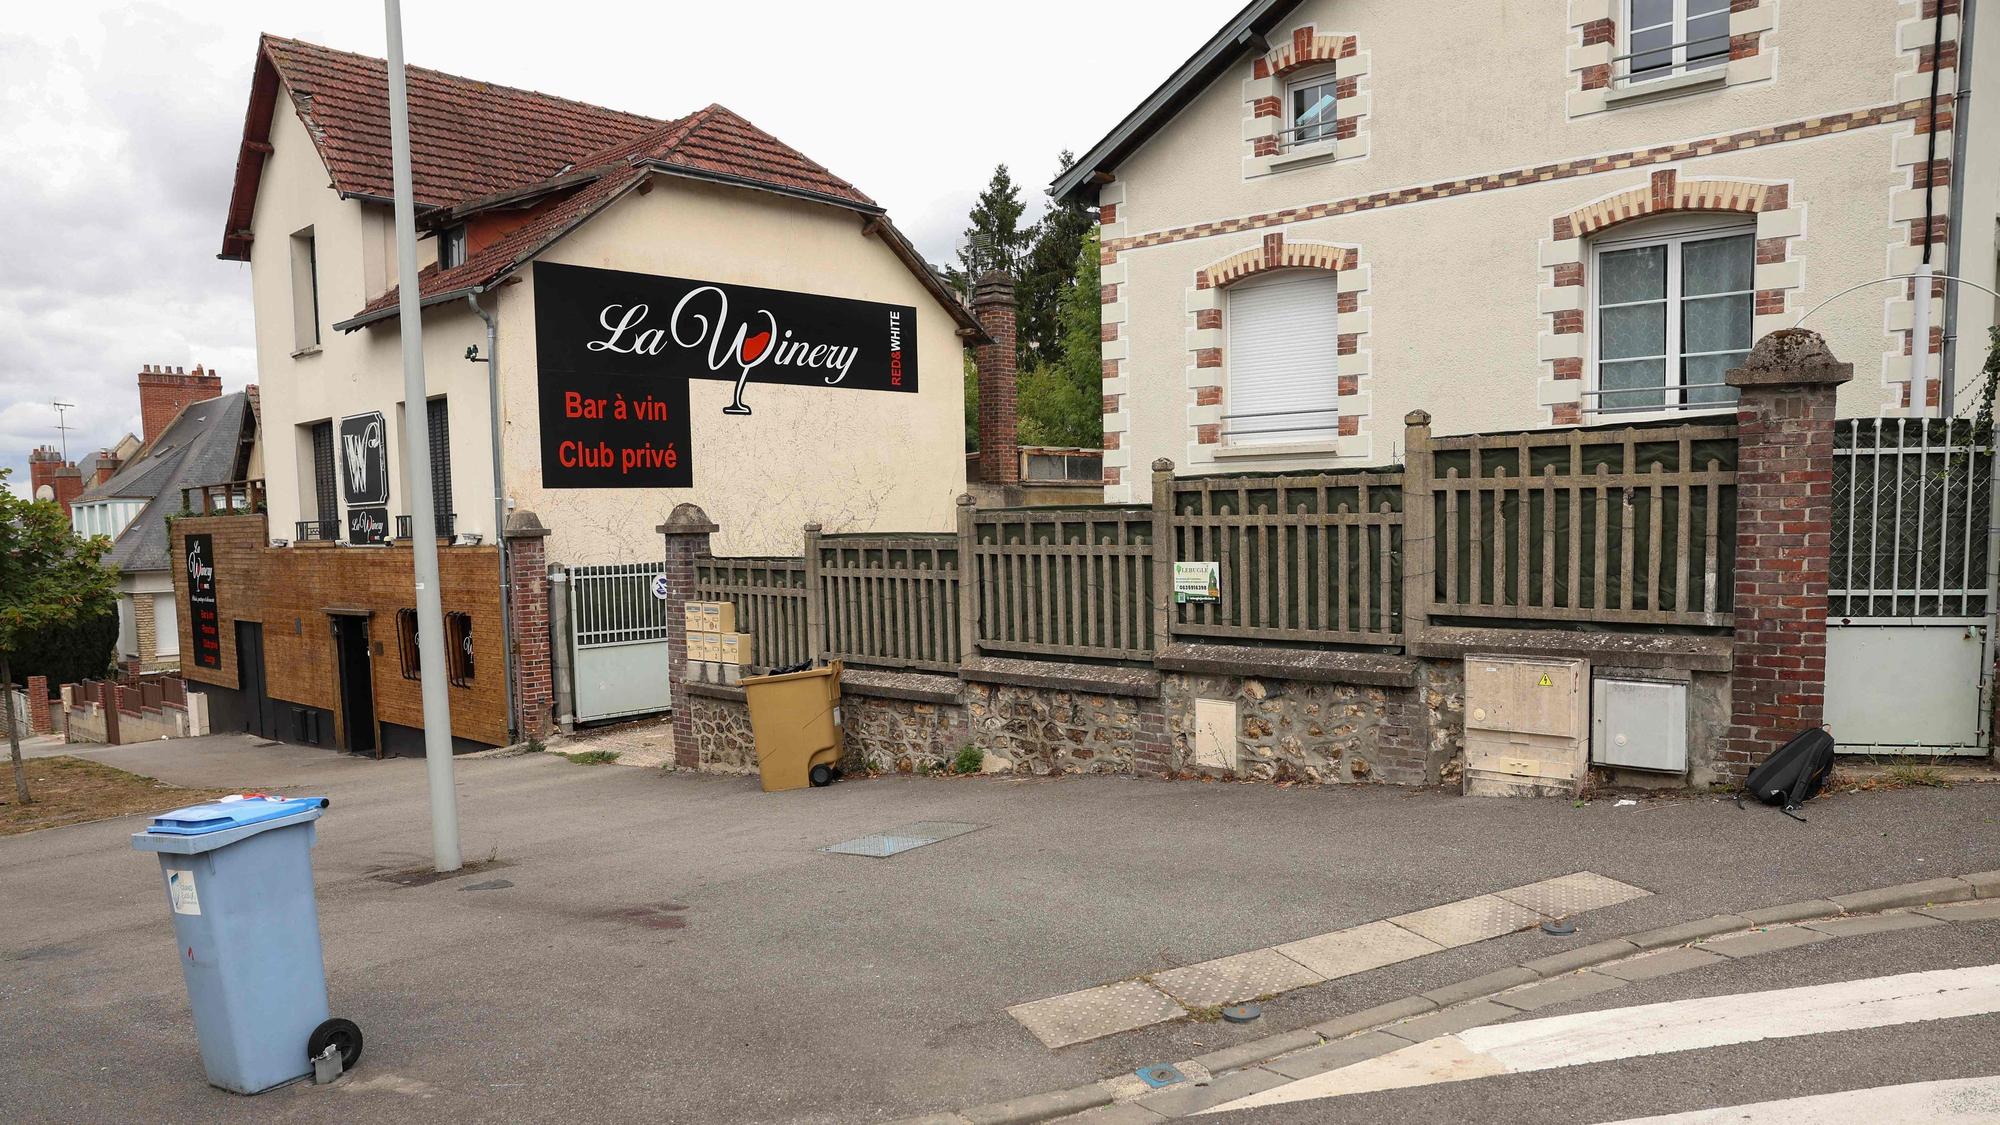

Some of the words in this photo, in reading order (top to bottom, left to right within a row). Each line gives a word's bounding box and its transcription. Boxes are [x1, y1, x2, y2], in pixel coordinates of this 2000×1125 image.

[586, 303, 667, 356] La
[670, 286, 859, 385] Winery
[889, 310, 902, 386] RED&WHITE
[564, 391, 607, 421] Bar
[613, 393, 628, 421] à
[636, 397, 668, 421] vin
[558, 440, 615, 469] Club
[621, 442, 678, 475] privé
